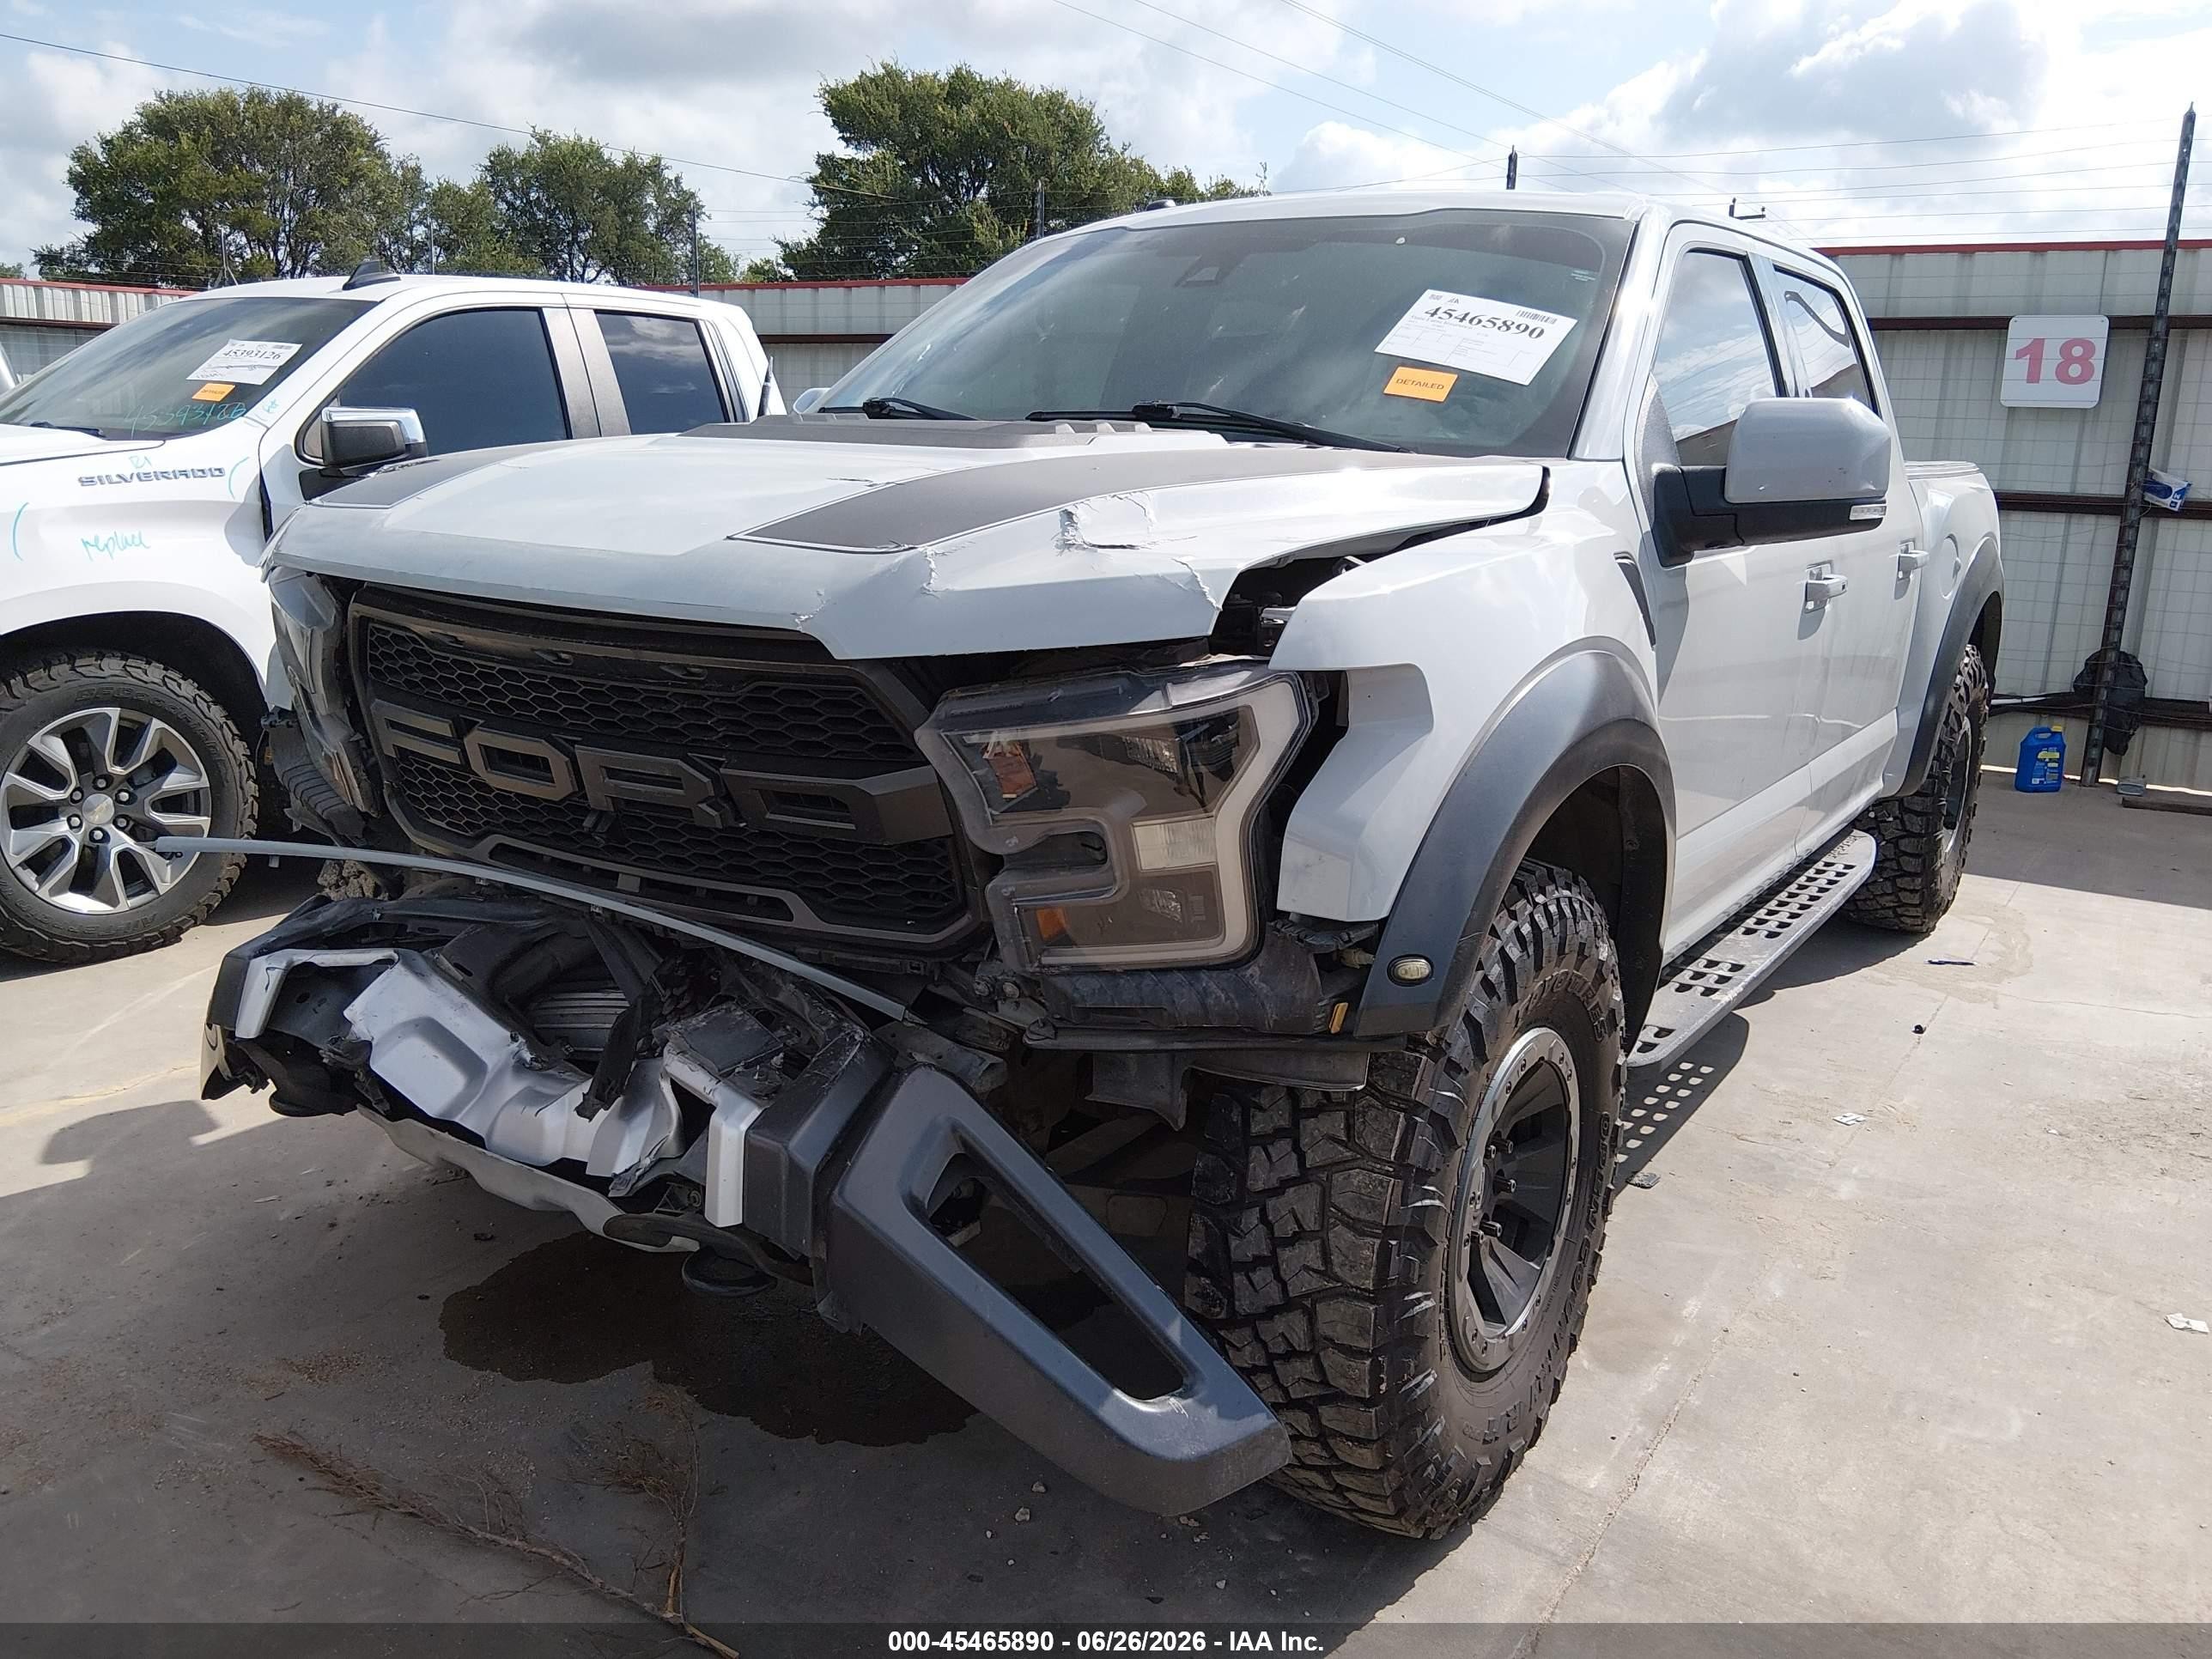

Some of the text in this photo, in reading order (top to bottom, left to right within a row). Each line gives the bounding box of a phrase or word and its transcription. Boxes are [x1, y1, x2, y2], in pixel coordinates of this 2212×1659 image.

[1424, 306, 1545, 339] 45465890
[222, 348, 282, 361] 45393126
[2015, 337, 2097, 386] 18
[1395, 377, 1445, 391] DETAILED
[78, 467, 227, 486] SILVERADO
[370, 698, 886, 846] FORD
